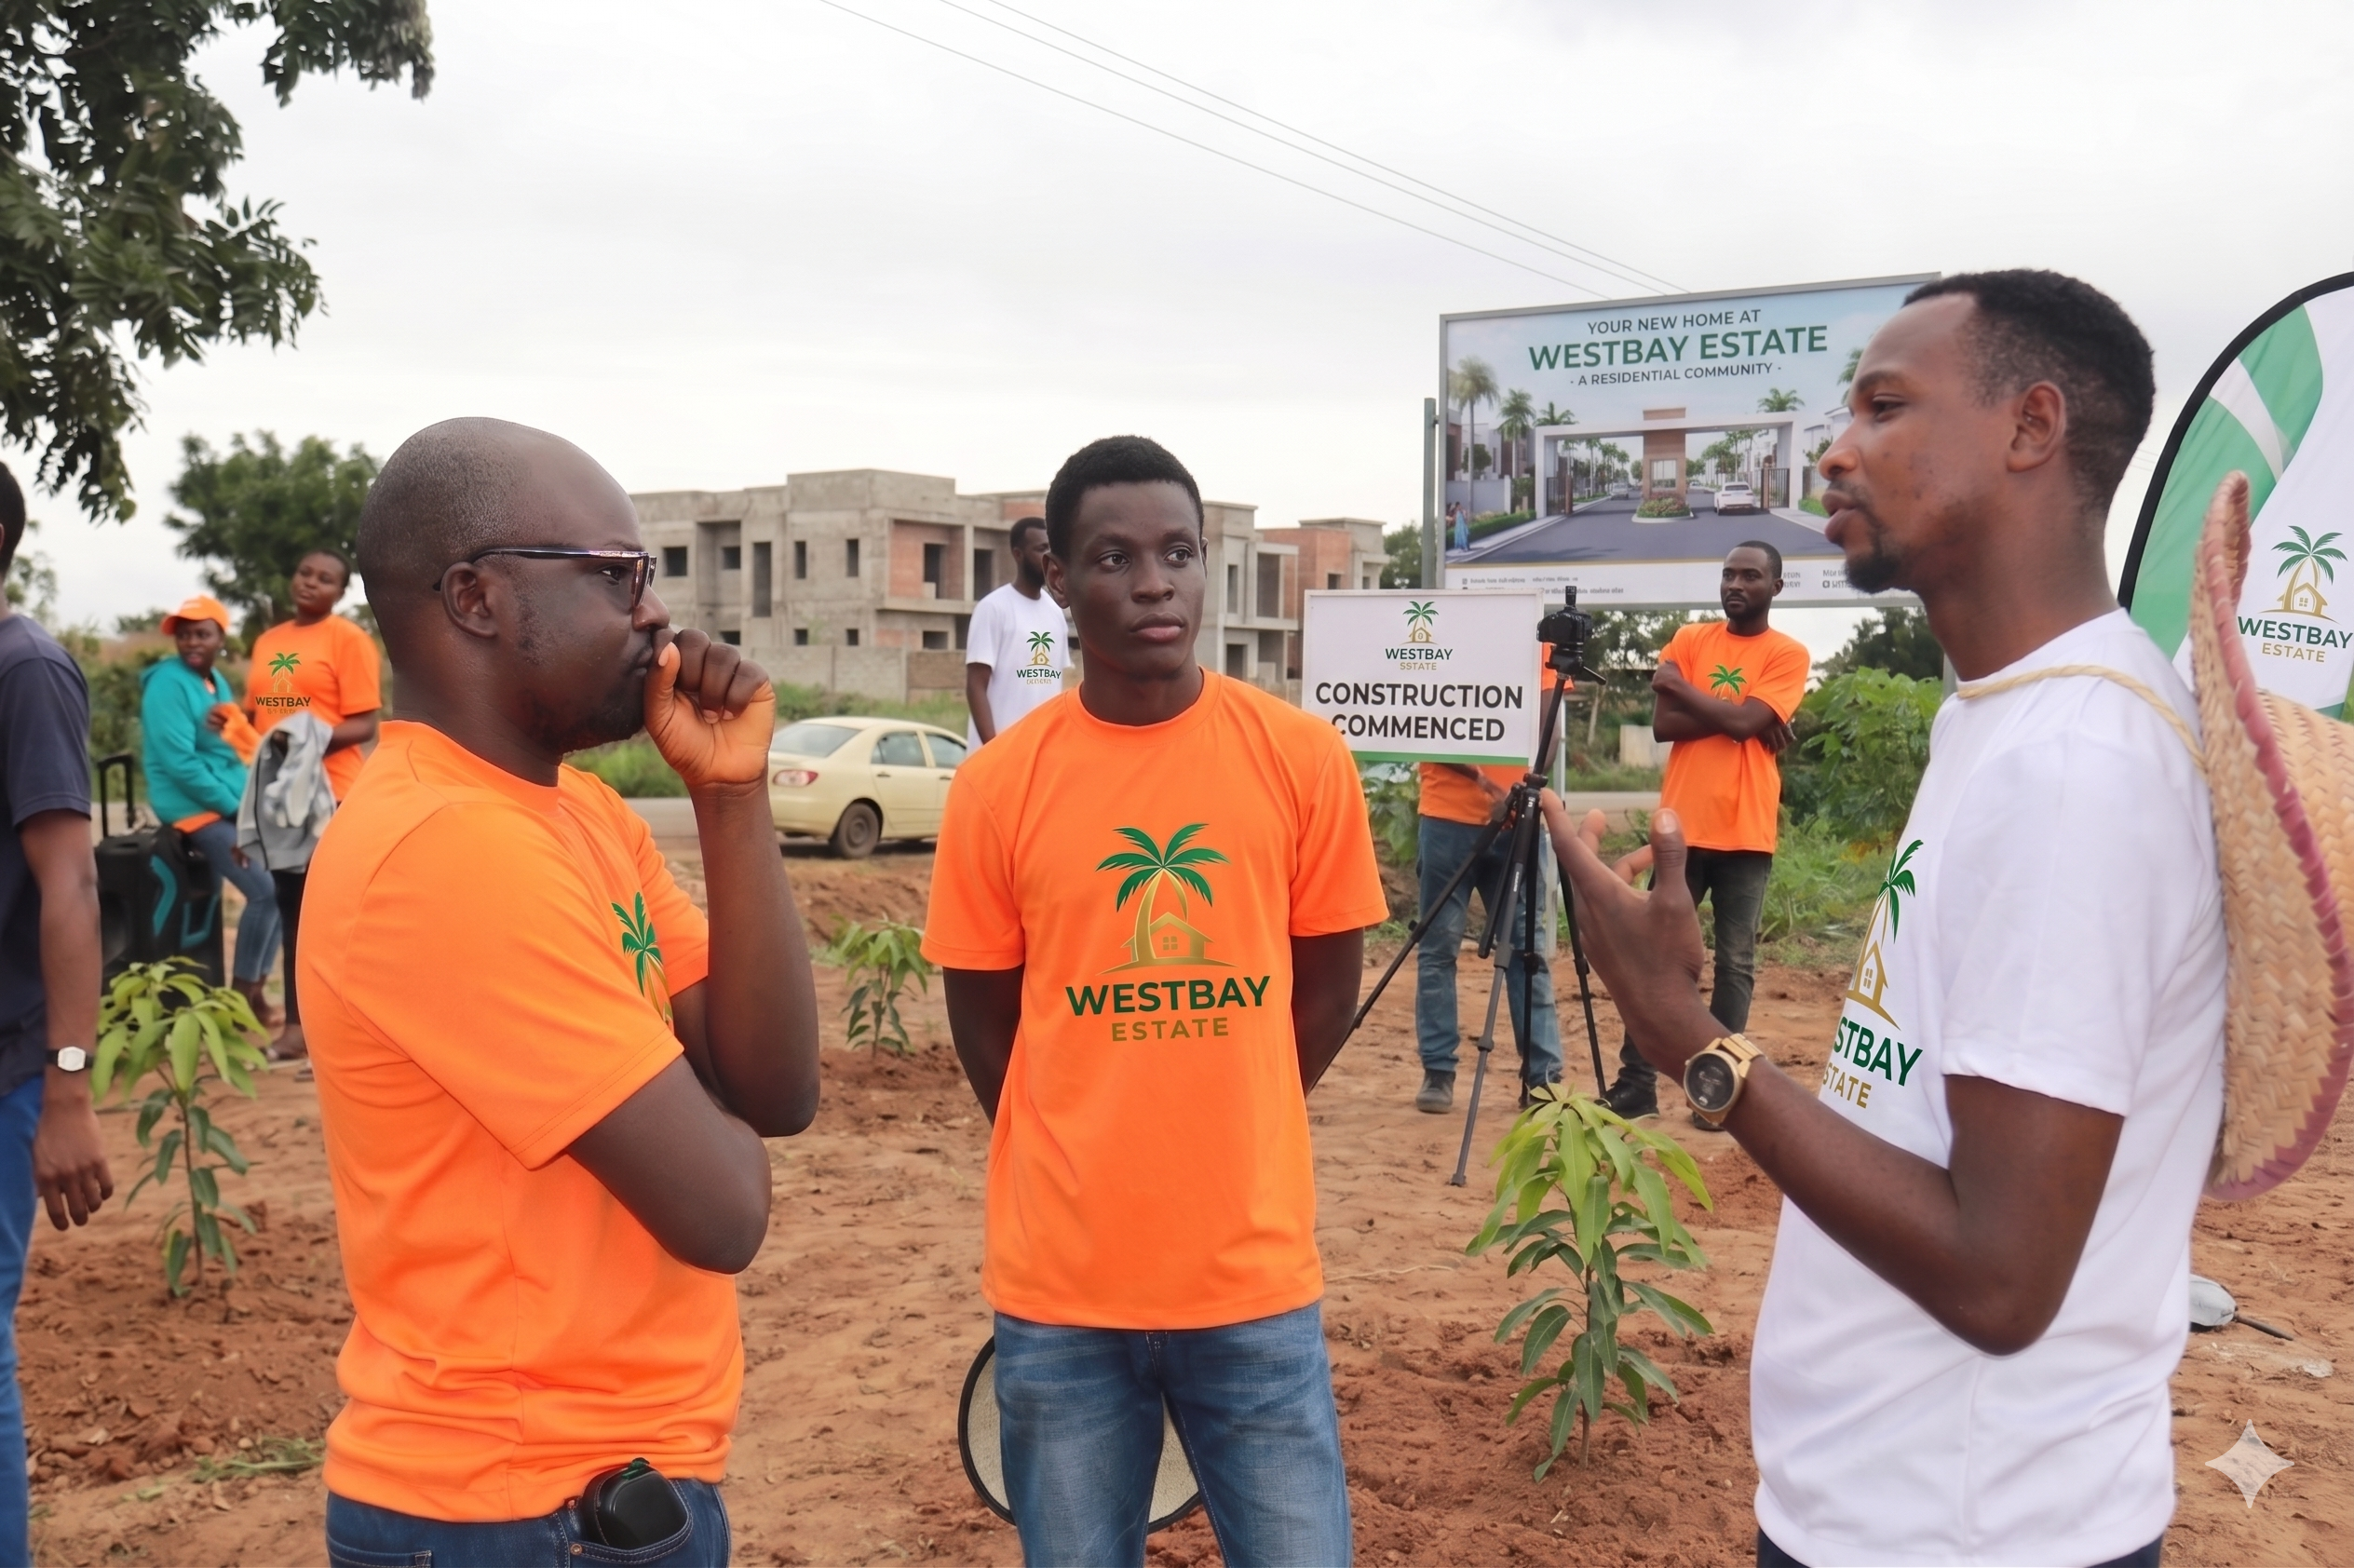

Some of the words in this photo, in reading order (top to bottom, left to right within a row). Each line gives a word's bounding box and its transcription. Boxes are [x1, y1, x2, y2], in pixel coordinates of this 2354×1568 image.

[1588, 319, 1632, 334] YOUR
[1638, 316, 1677, 331] NEW
[1683, 311, 1734, 328] HOME
[1739, 309, 1761, 323] AT
[1528, 335, 1689, 371] WESTBAY
[1700, 326, 1827, 359] ESTATE
[1578, 375, 1588, 385] A
[1591, 369, 1681, 385] RESIDENTIAL
[1684, 363, 1773, 379] COMMUNITY
[2238, 616, 2353, 649] WESTBAY
[1385, 648, 1454, 660] WESTBAY
[2262, 642, 2325, 663] ESTATE
[1016, 669, 1062, 679] WESTBAY
[255, 696, 311, 708] WESTBAY
[1316, 682, 1523, 709] CONSTRUCTION
[1332, 713, 1505, 741] COMMENCED
[1065, 975, 1271, 1017] WESTBAY
[1111, 1017, 1229, 1042] ESTATE
[1833, 1016, 1924, 1088] STBAY
[1822, 1061, 1872, 1109] STATE
